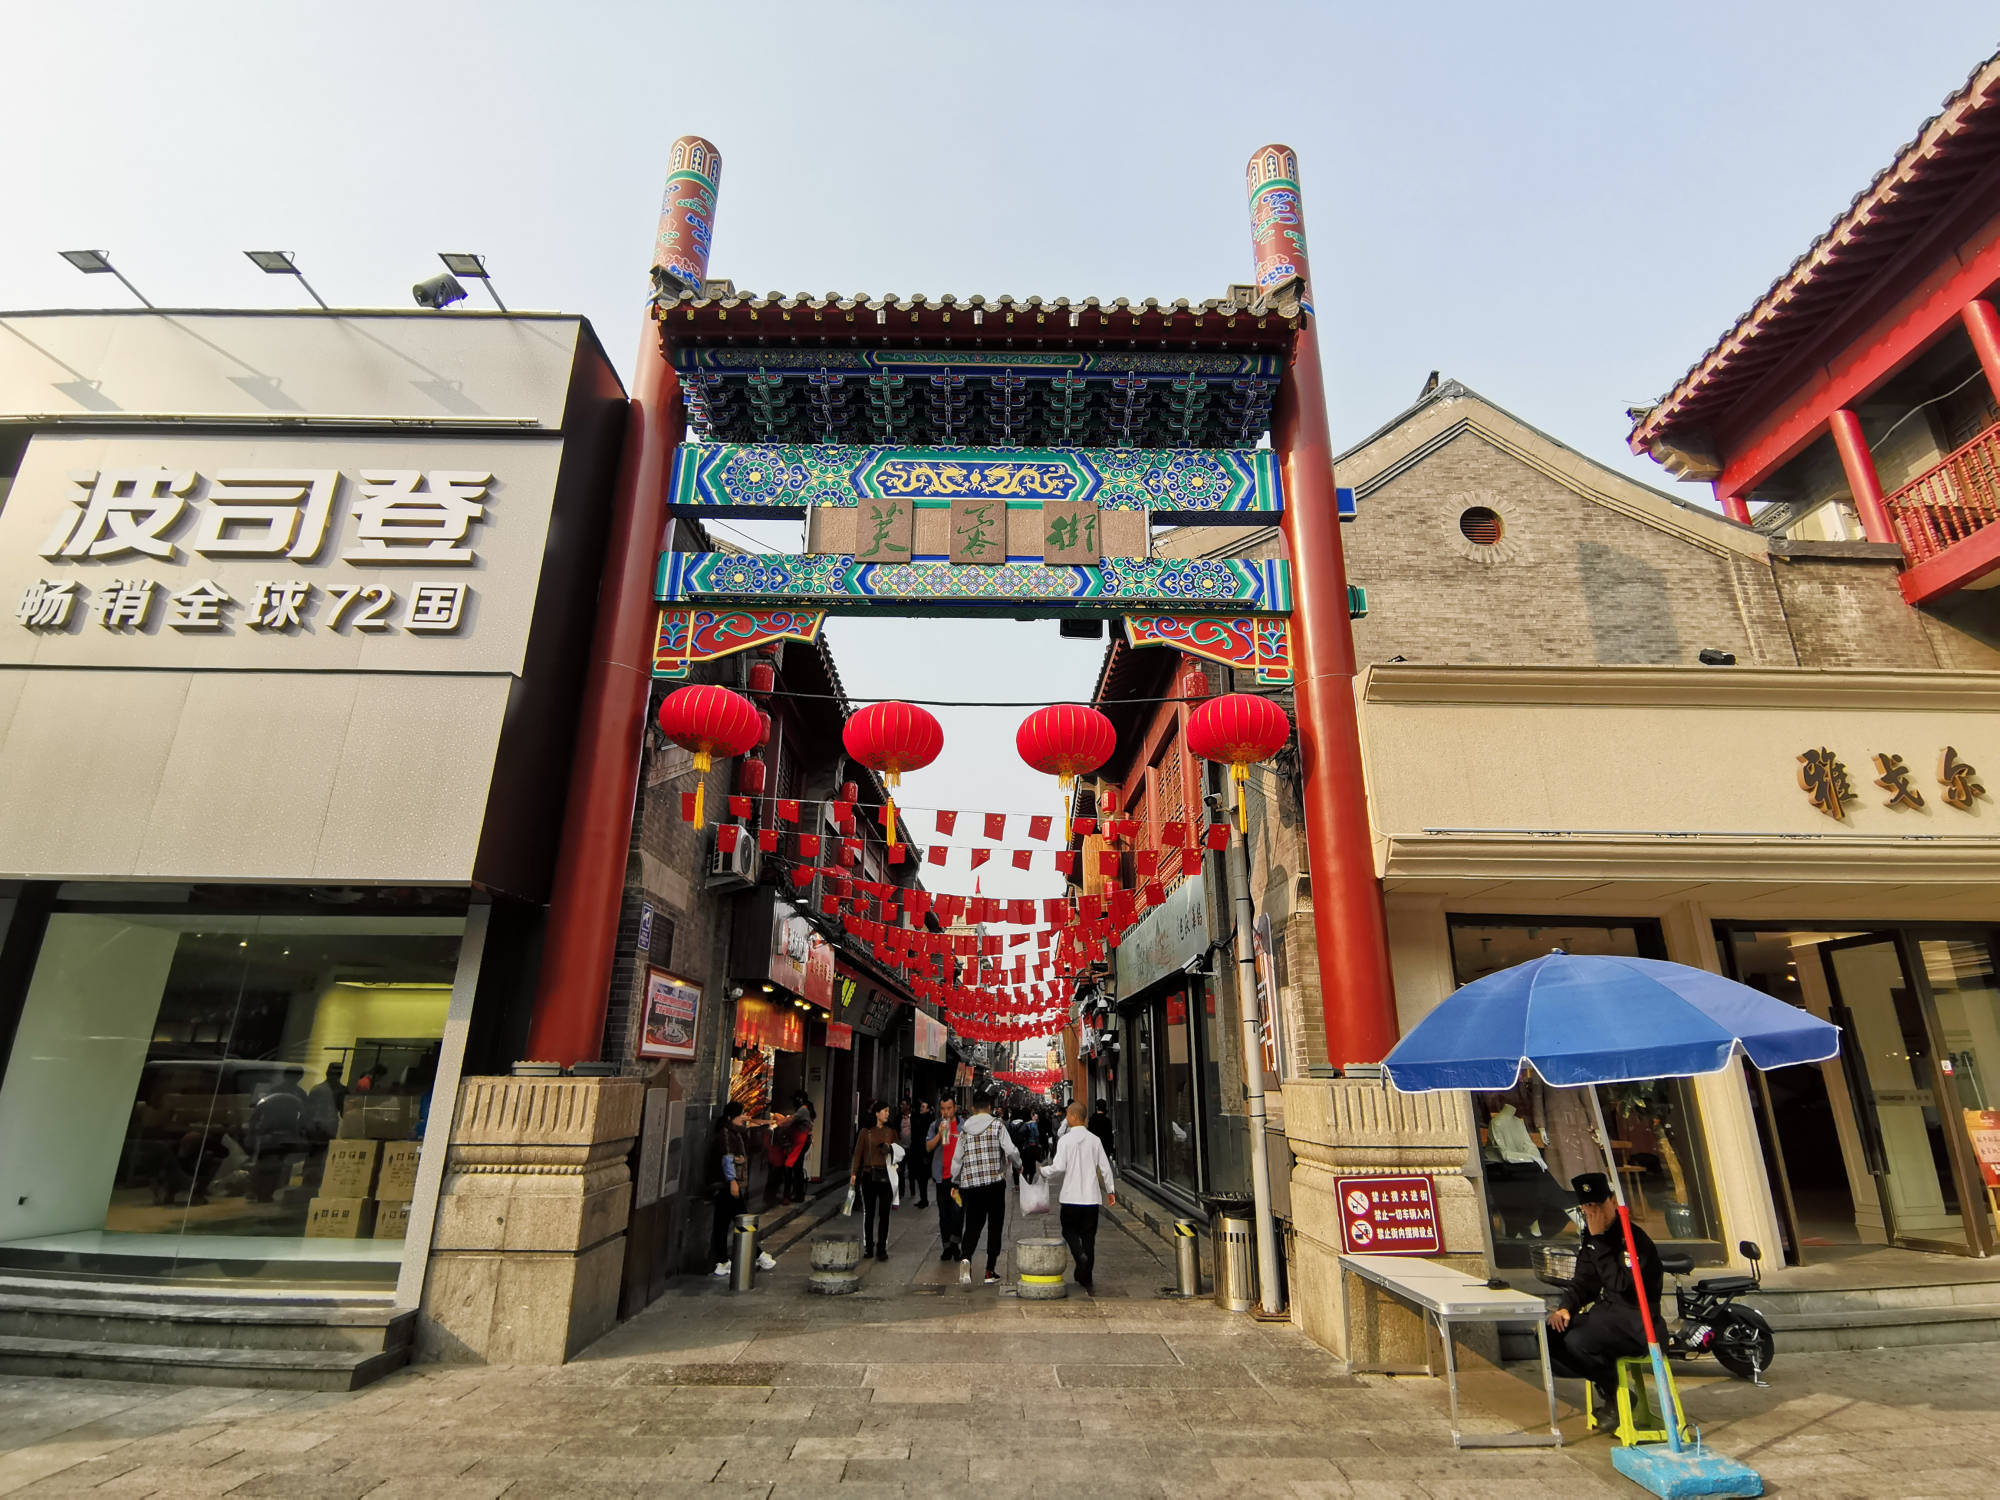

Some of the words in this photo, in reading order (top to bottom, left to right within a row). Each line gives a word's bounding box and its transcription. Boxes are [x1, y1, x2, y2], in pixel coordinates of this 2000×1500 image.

[39, 467, 495, 566] 波司登
[861, 503, 1098, 557] 芙蓉街
[15, 580, 469, 634] 畅销全球72国
[1796, 746, 1987, 820] 雅戈尔
